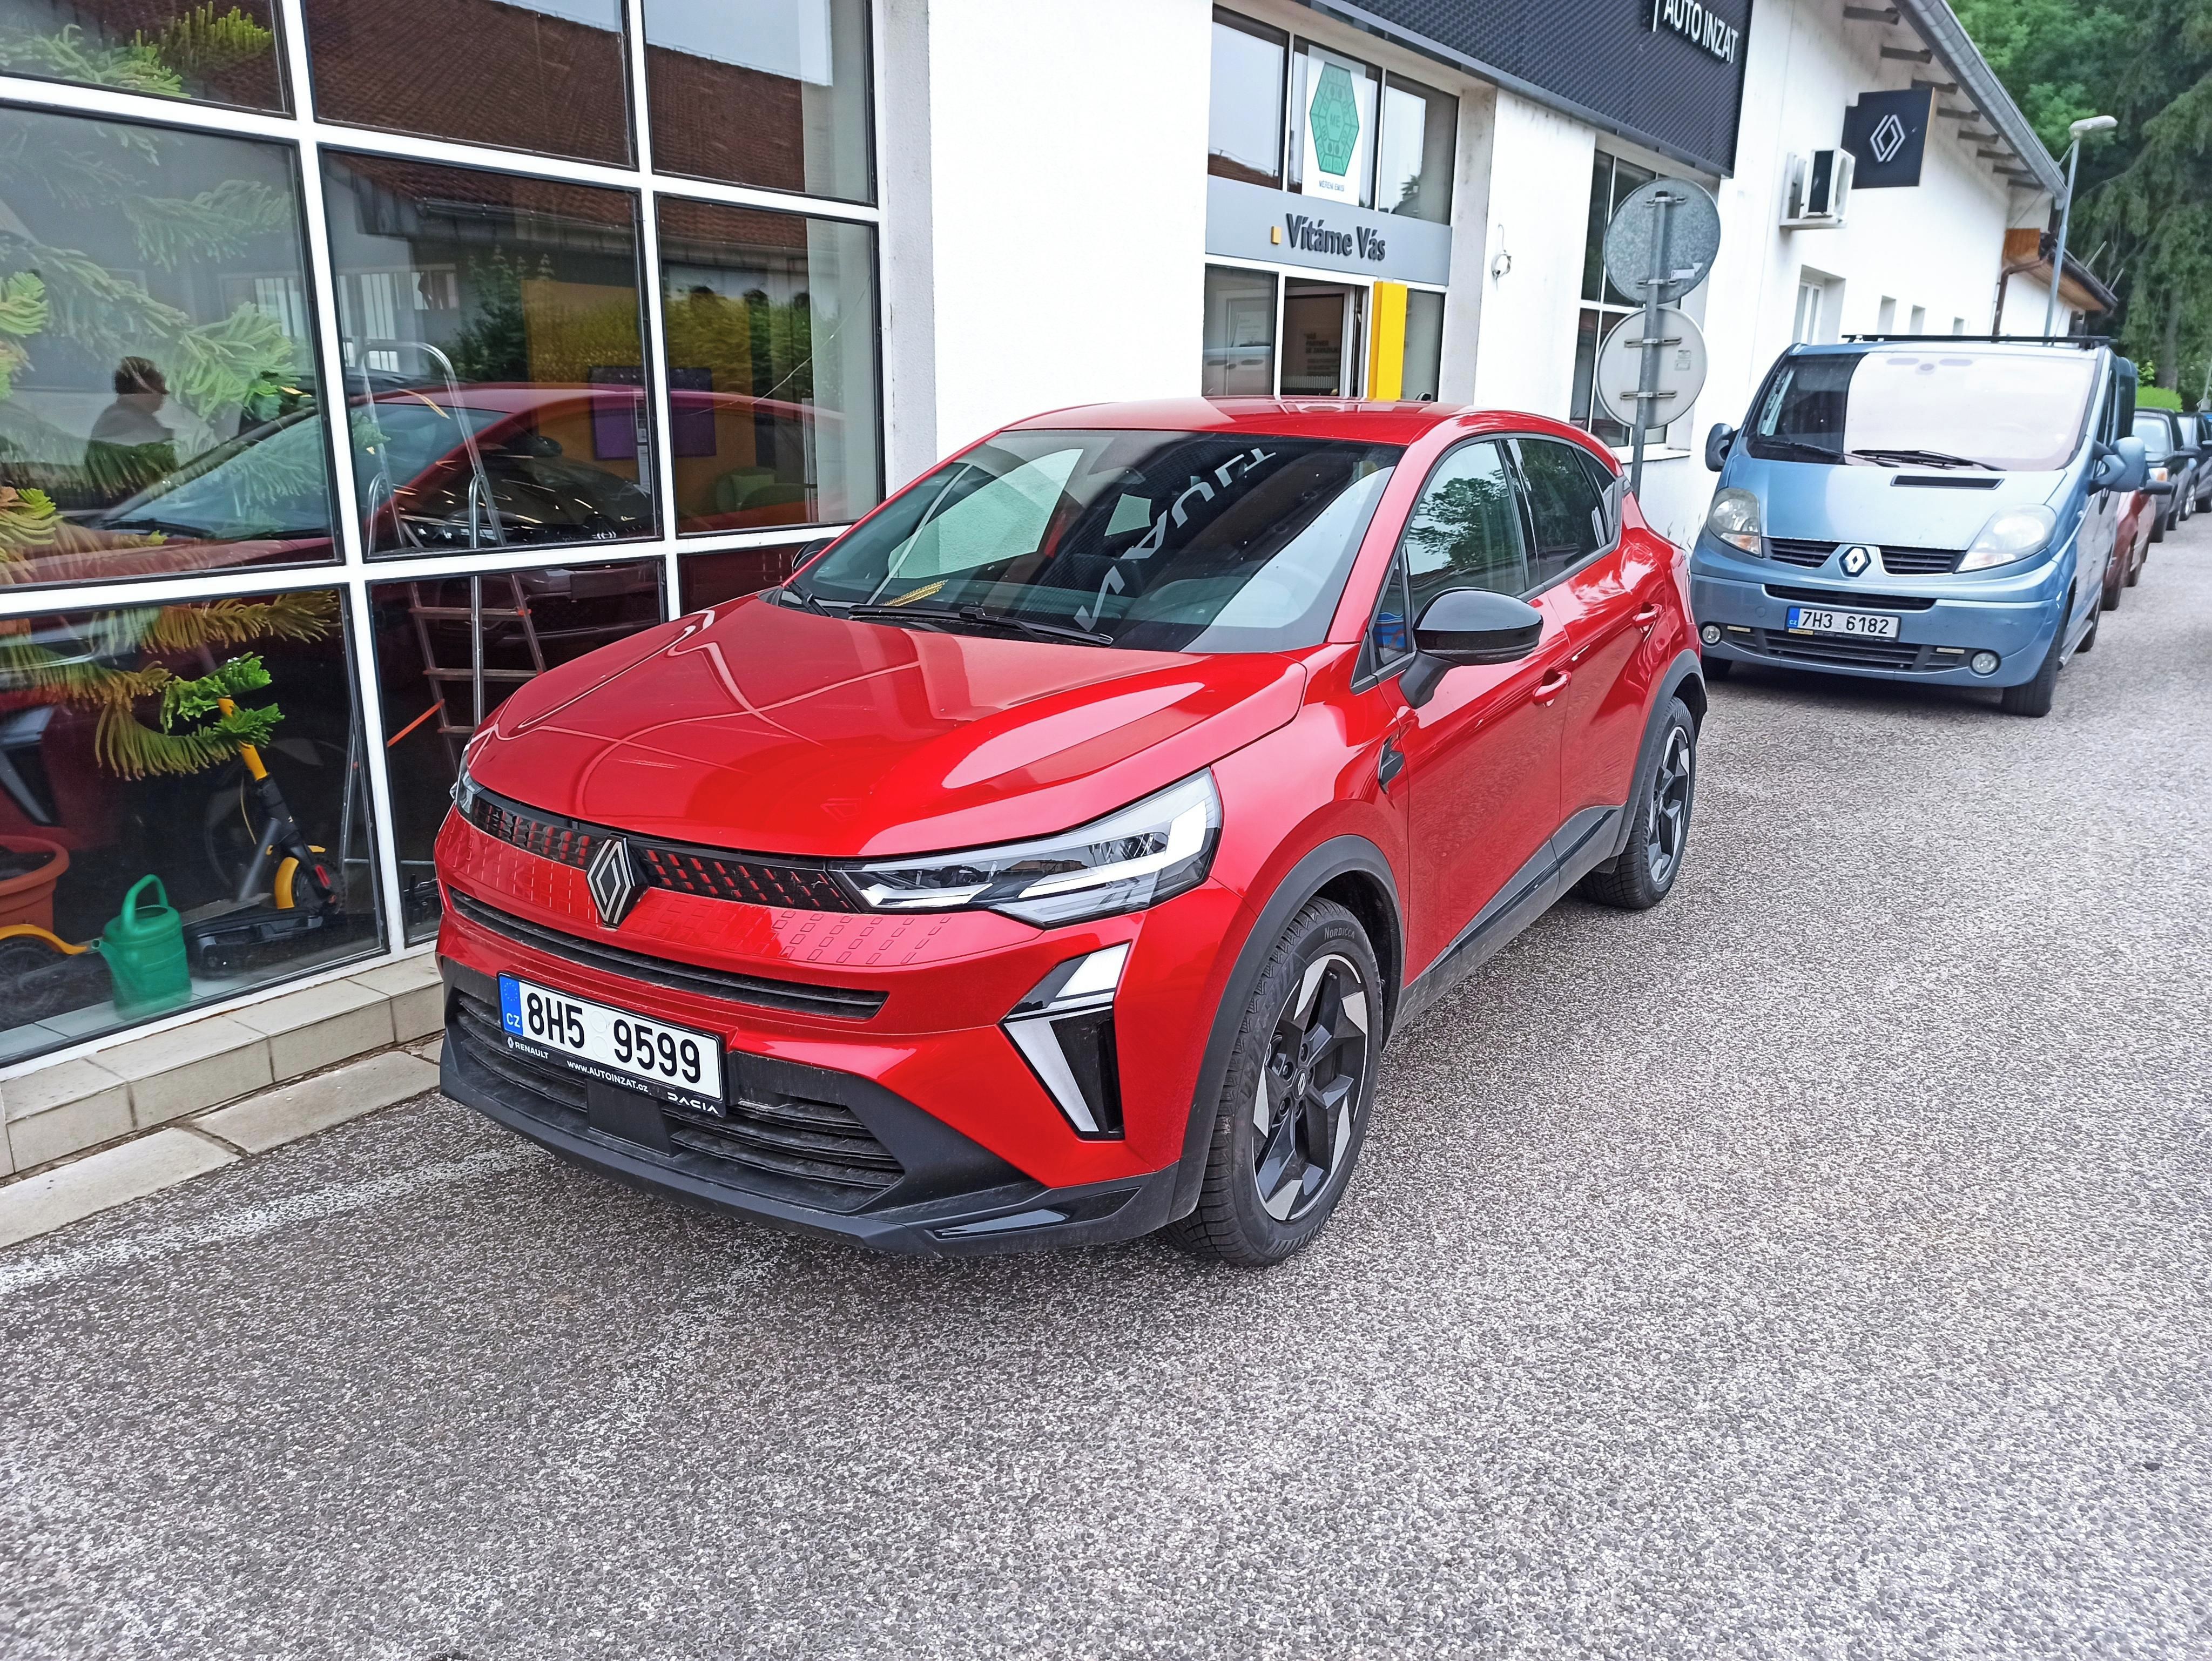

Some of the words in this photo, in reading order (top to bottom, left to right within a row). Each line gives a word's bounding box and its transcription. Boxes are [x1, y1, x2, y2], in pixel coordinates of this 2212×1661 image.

[1663, 0, 1702, 42] AUTO
[1702, 10, 1738, 64] INZAT
[1330, 113, 1341, 127] ME
[1286, 213, 1353, 256] Vítáme
[1356, 226, 1386, 261] Vás
[1802, 611, 1833, 629] 7H3
[1846, 616, 1889, 634] 6182
[506, 1012, 521, 1028] CZ
[527, 992, 584, 1049] 8H5
[613, 1019, 701, 1084] 9599
[515, 1041, 549, 1059] RENAULT
[667, 1091, 719, 1115] DACIA
